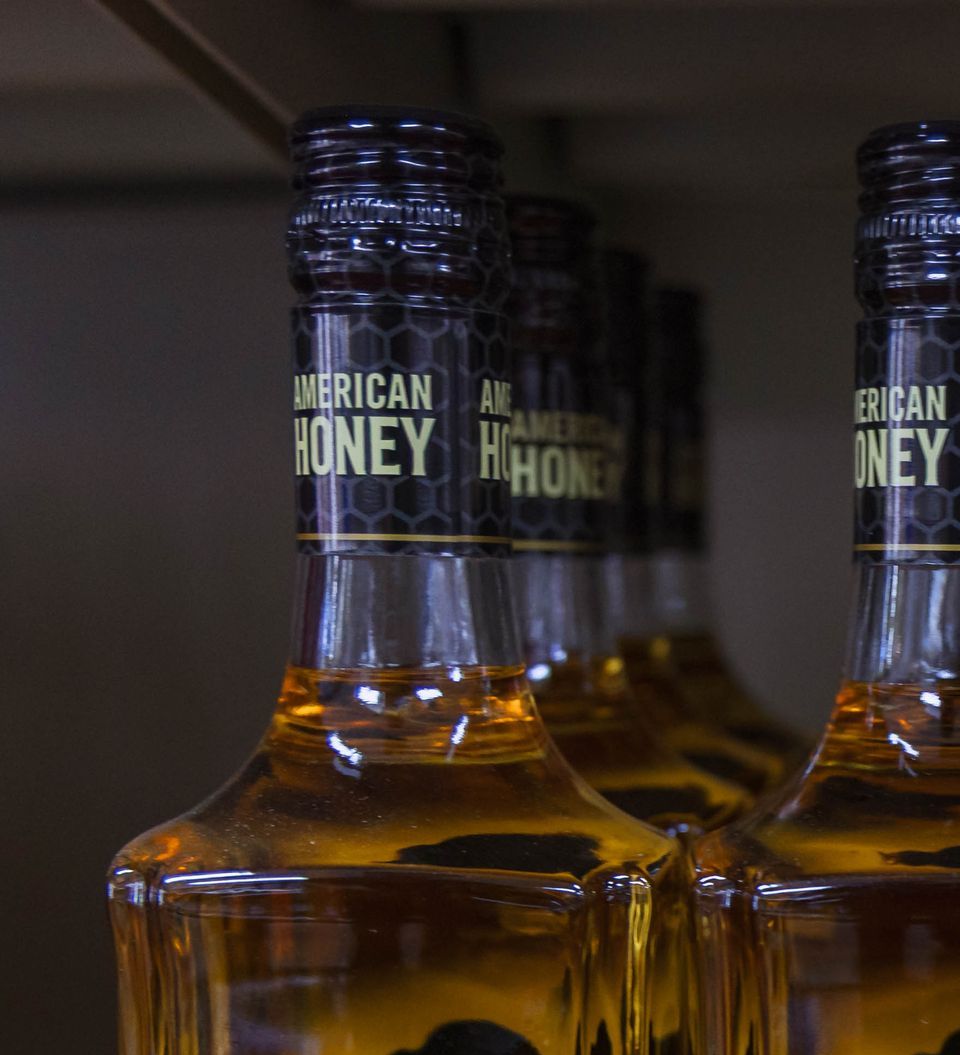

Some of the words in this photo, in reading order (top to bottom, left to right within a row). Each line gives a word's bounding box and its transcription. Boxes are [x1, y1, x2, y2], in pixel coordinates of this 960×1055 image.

[293, 372, 433, 411] AMERICAN
[854, 385, 947, 424] ERICAN
[294, 415, 436, 477] HONEY
